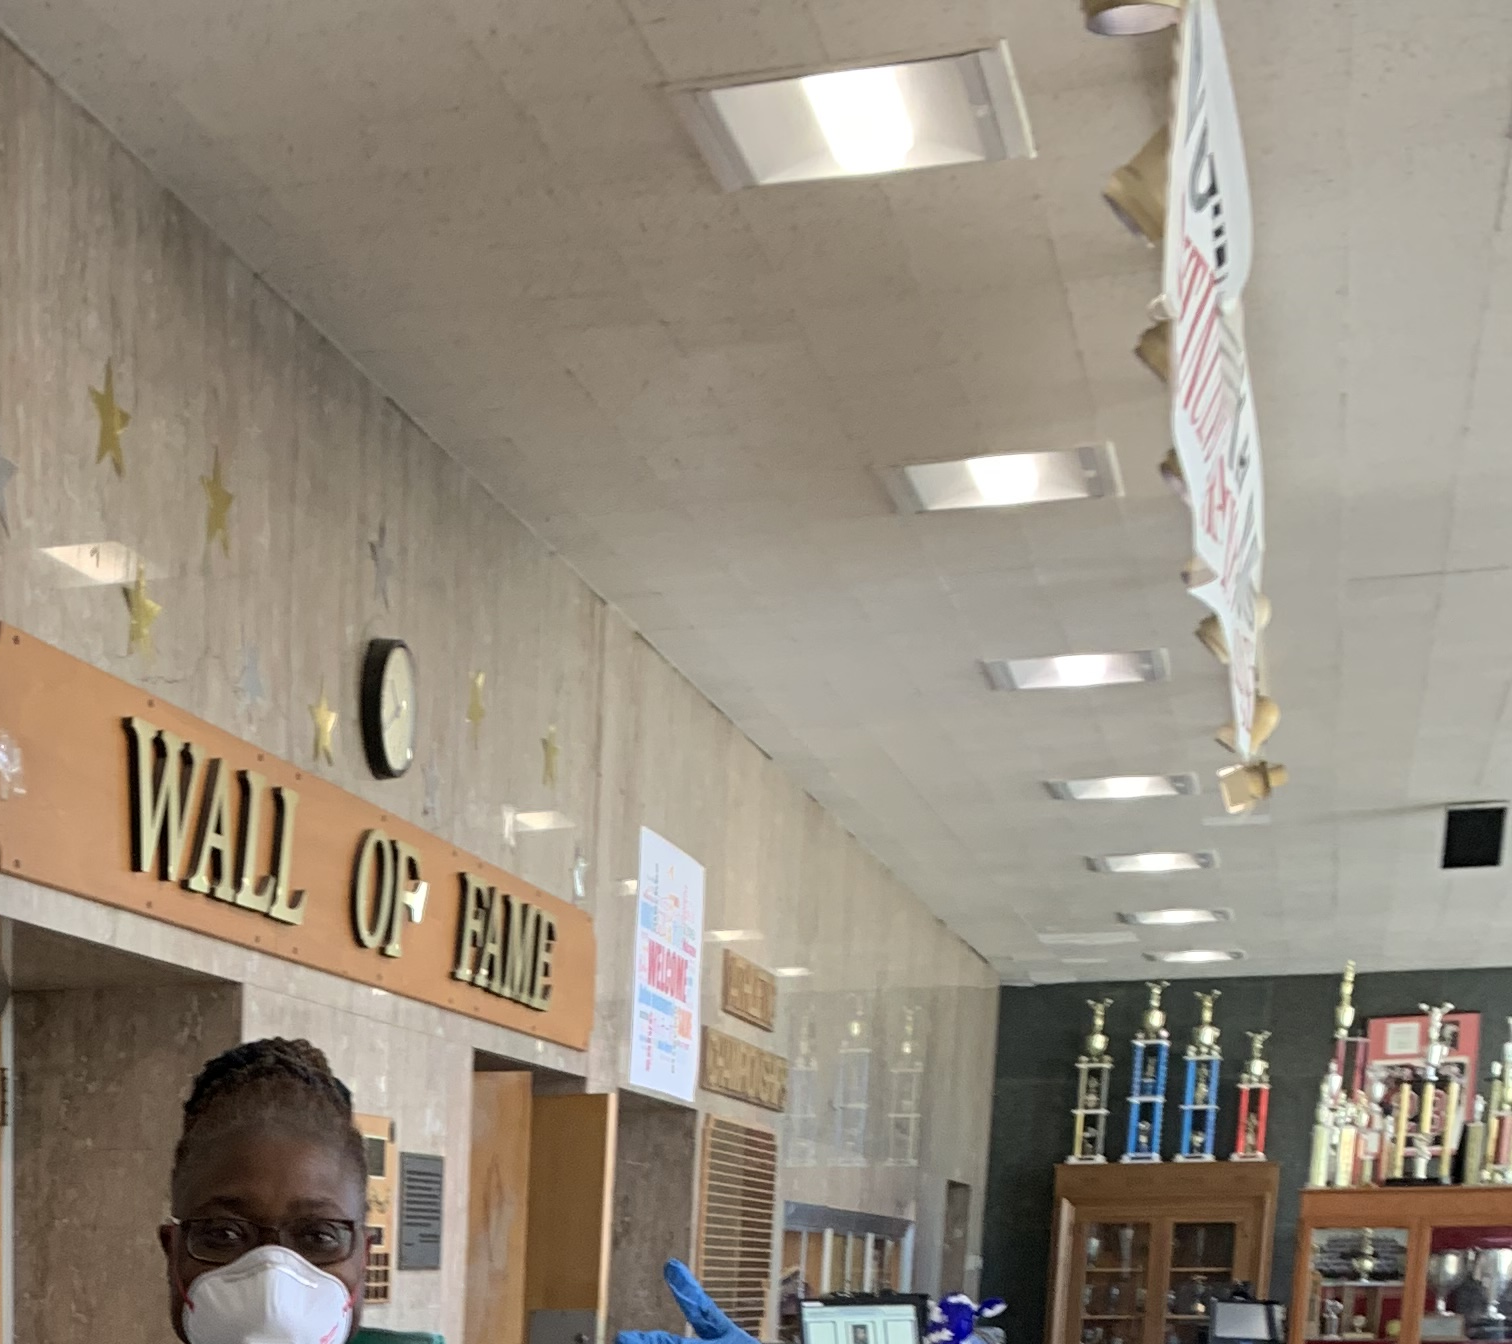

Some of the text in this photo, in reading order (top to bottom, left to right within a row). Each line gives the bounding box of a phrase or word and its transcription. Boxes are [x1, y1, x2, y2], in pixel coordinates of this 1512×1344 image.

[123, 715, 307, 926] WALL
[350, 828, 429, 958] OF
[450, 871, 558, 1012] FAME
